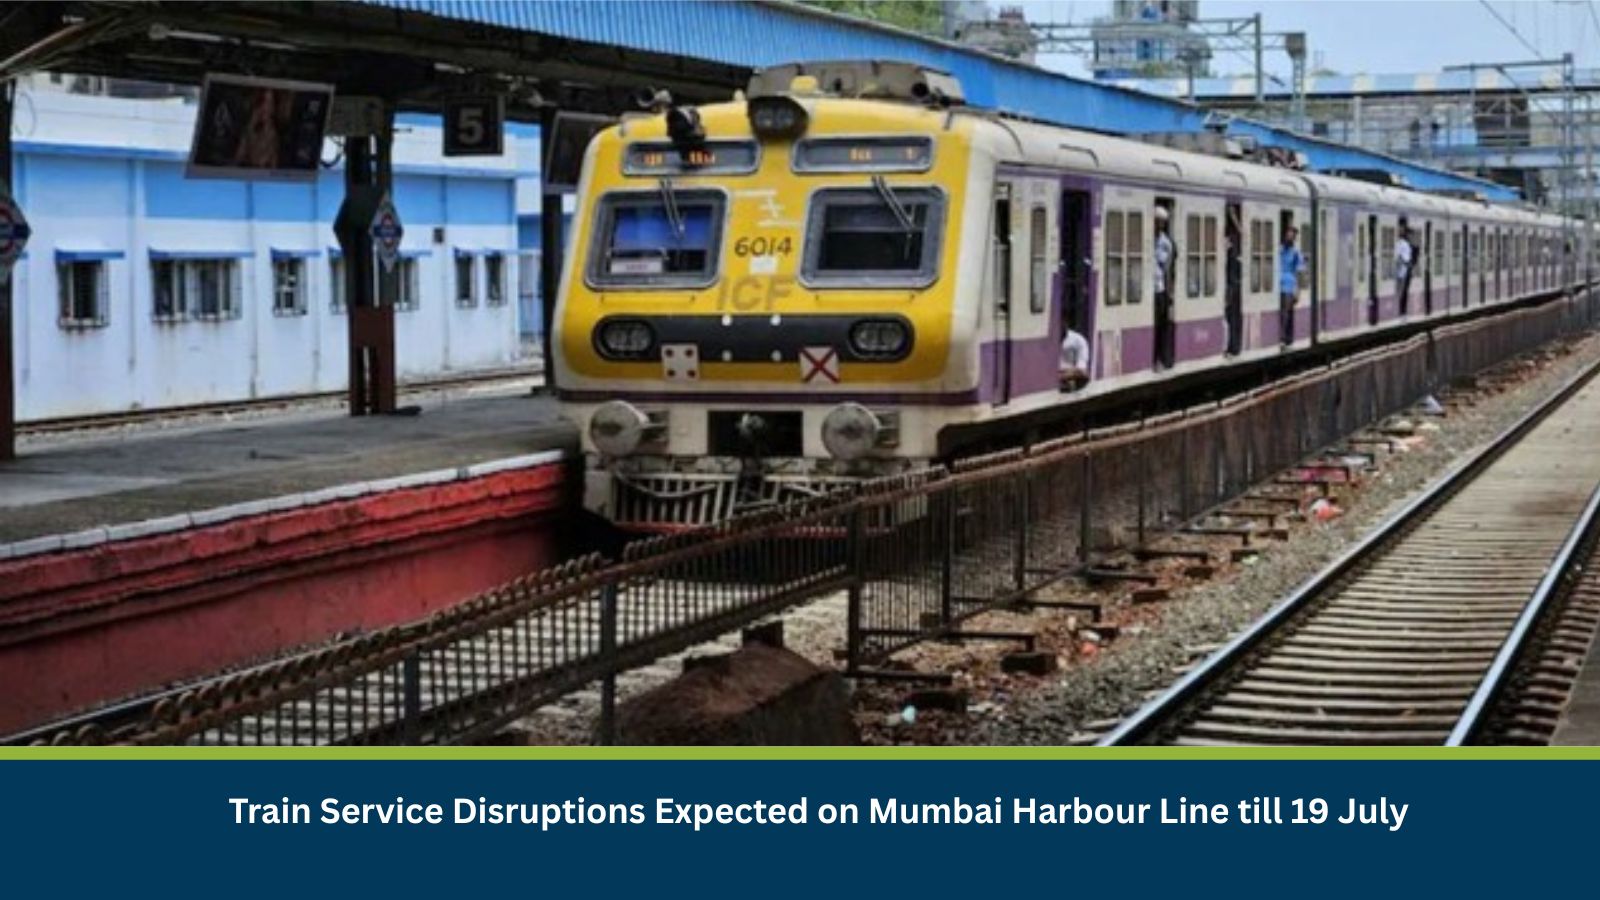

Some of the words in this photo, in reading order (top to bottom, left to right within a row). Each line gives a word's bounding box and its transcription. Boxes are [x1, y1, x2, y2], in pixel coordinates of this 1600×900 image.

[459, 107, 484, 145] 5
[734, 235, 793, 258] 6014
[716, 275, 795, 312] ICF
